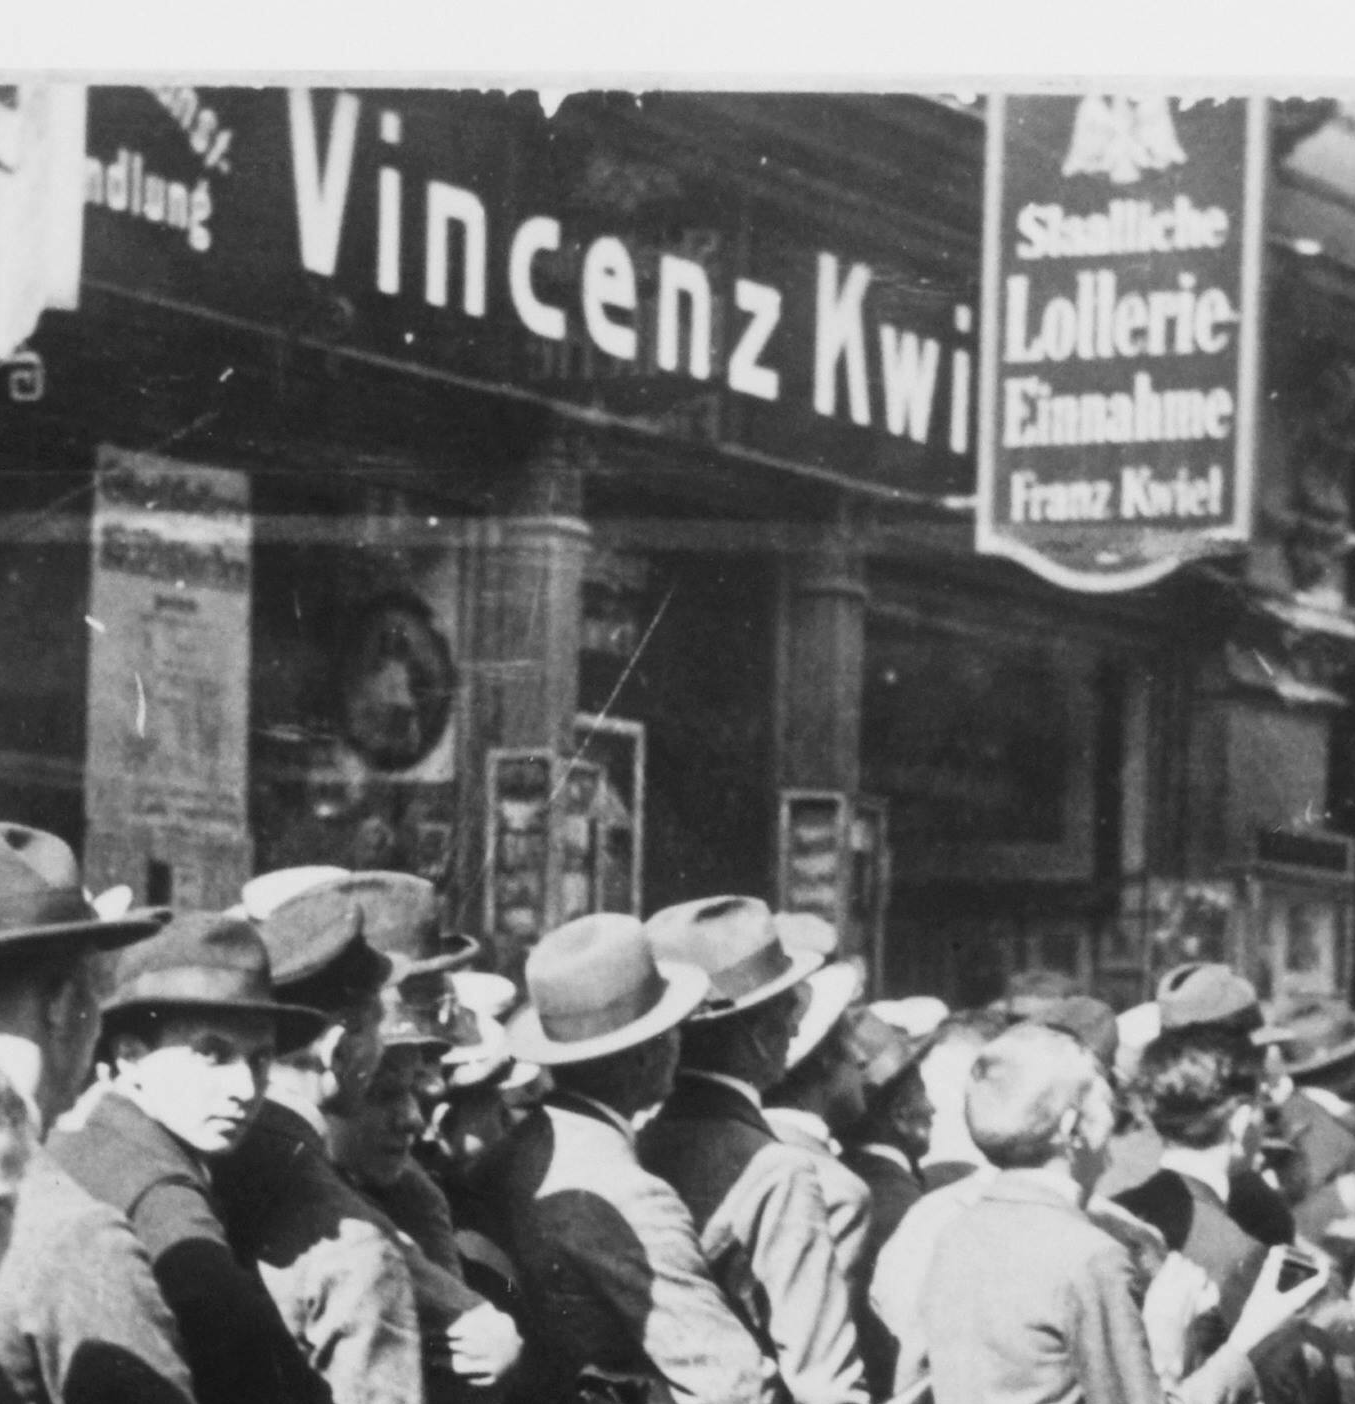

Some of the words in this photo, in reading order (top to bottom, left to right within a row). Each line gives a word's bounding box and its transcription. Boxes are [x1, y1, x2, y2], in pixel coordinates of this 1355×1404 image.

[288, 87, 782, 401] Vincenz
[1002, 371, 1235, 449] Einnahme
[1009, 470, 1112, 523] Franz
